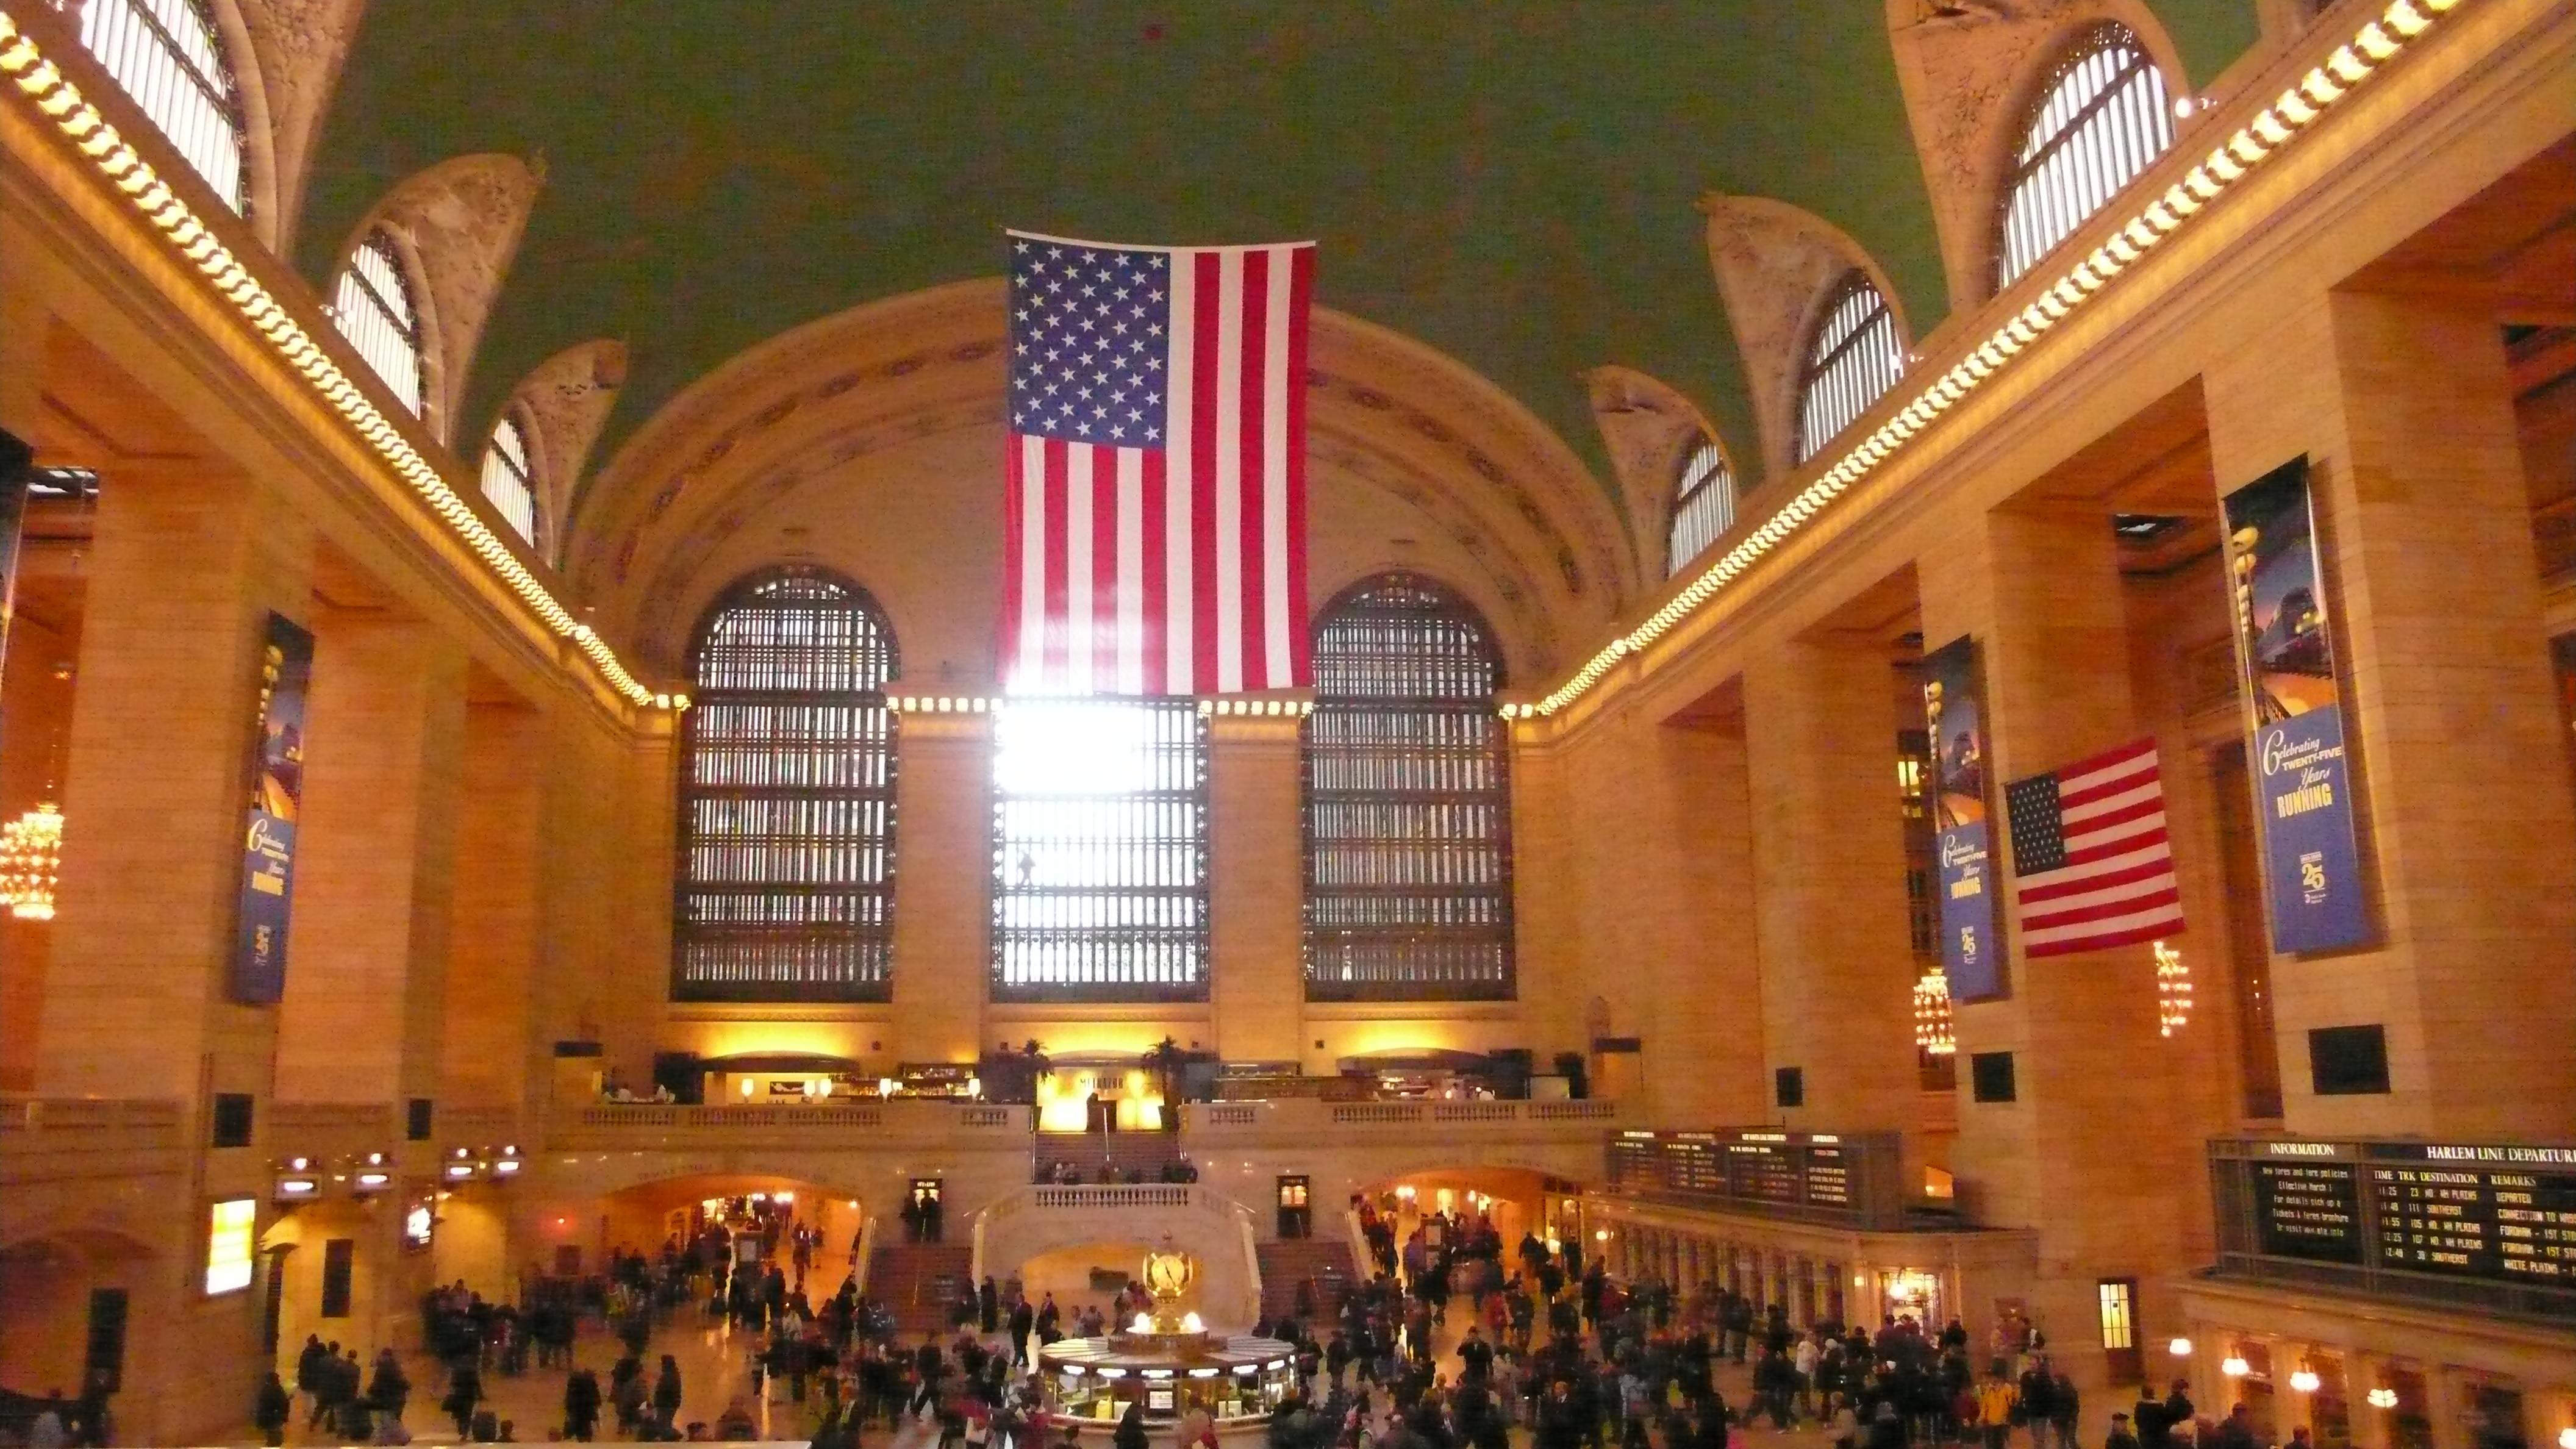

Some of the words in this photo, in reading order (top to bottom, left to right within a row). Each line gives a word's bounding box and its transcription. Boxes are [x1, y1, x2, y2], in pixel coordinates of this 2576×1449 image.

[2263, 730, 2320, 776] Celebrating
[2282, 746, 2342, 771] TWENTY-FIVE
[2298, 767, 2331, 792] Years
[2277, 783, 2332, 818] RUNNING
[2302, 863, 2325, 889] 25
[1962, 934, 1976, 953] 25
[2270, 1143, 2334, 1155] INFORMATION
[2427, 1147, 2475, 1159] HARLEM
[2478, 1147, 2505, 1160] LINE
[2321, 1169, 2348, 1178] policies
[2374, 1170, 2393, 1180] TIME
[2398, 1171, 2416, 1181] TRK
[2420, 1172, 2478, 1184] DESTINATION
[2491, 1175, 2536, 1187] REMARKS
[2410, 1187, 2419, 1197] 23
[2452, 1190, 2477, 1201] PLAINS
[2496, 1192, 2531, 1204] DEPARTED
[2427, 1204, 2462, 1215] SOUTHEAST
[2498, 1209, 2543, 1222] CONNECTION
[2546, 1211, 2556, 1222] TO
[2456, 1222, 2480, 1233] PLAINS
[2500, 1225, 2531, 1238] FORDHAM
[2544, 1229, 2558, 1239] 1ST
[2457, 1238, 2483, 1249] PLAINS
[2546, 1246, 2560, 1258] 1ST
[2431, 1251, 2468, 1264] SOUTHEAST
[2504, 1259, 2527, 1270] WHITE
[2530, 1261, 2558, 1275] PLAINS
